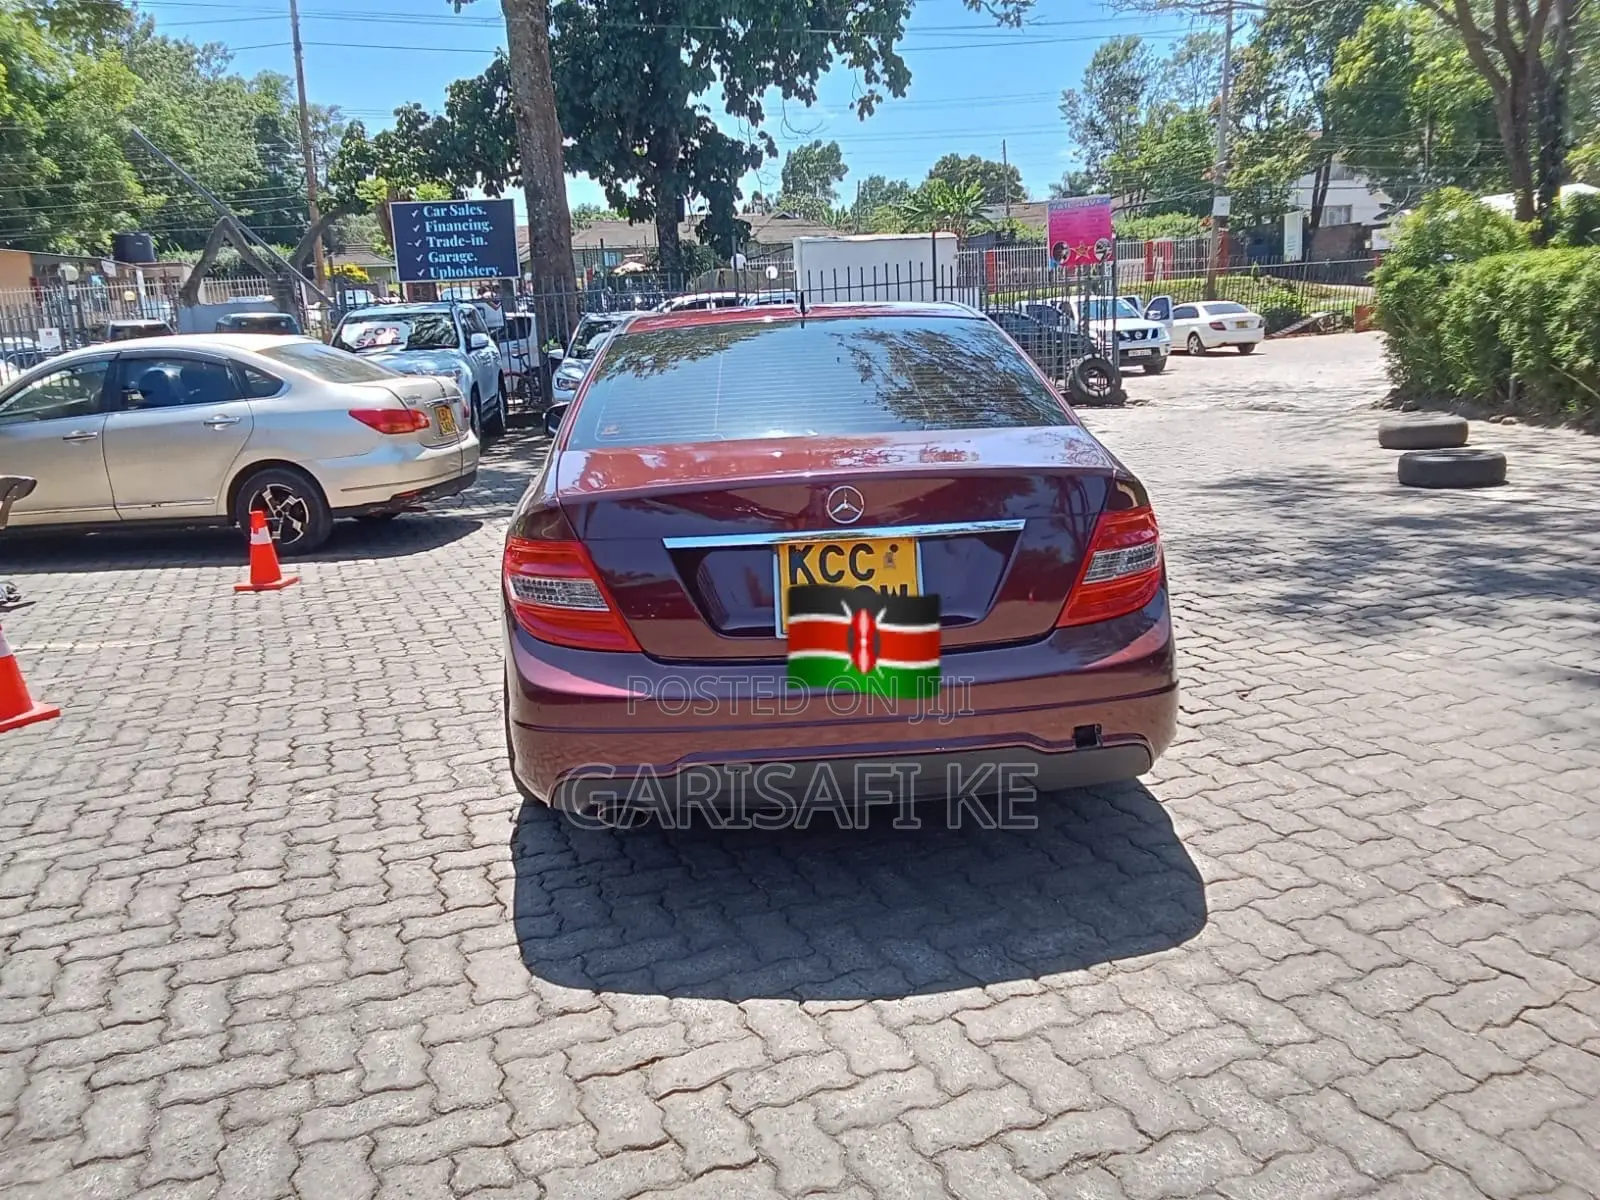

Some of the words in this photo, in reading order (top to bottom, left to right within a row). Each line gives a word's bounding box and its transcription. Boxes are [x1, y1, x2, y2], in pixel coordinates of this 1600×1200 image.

[423, 205, 447, 217] Car
[450, 203, 487, 217] Sales.
[424, 218, 494, 233] Financing.
[426, 234, 489, 248] Trade-in.
[428, 251, 478, 264] Garage.
[429, 265, 502, 280] Upholstery.
[363, 327, 400, 336] FOR
[355, 337, 402, 347] SALE
[787, 542, 876, 585] KCC
